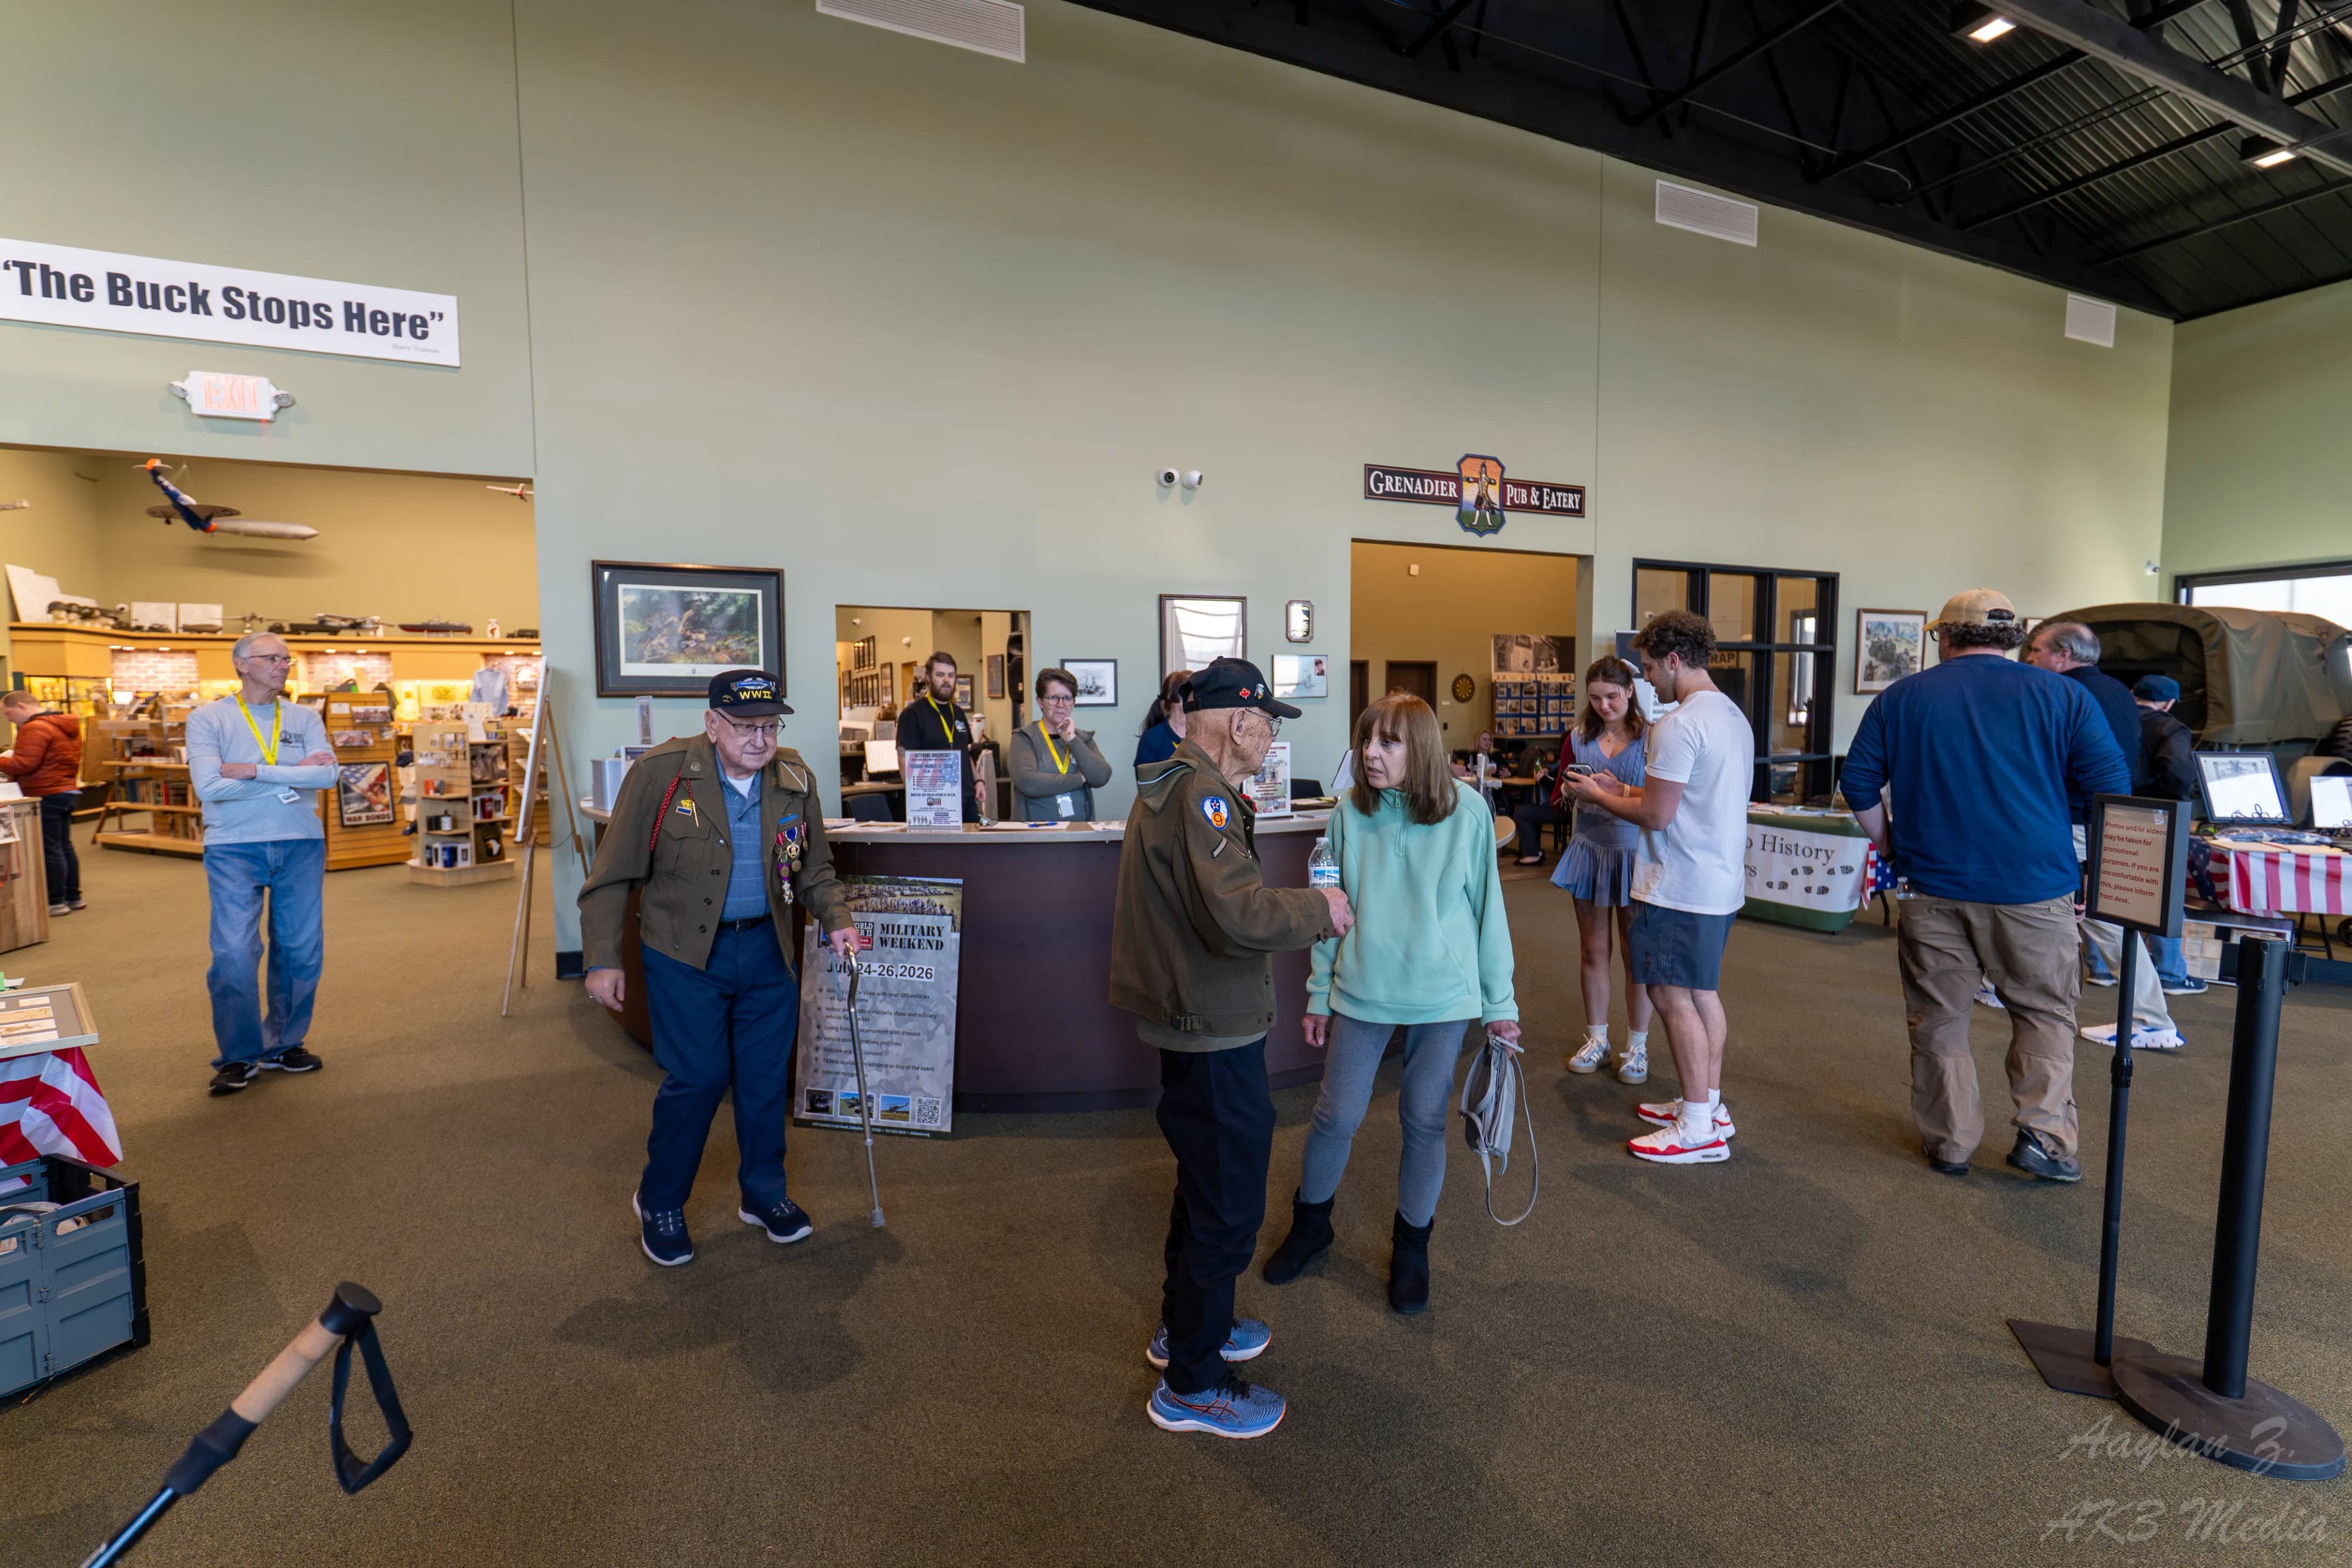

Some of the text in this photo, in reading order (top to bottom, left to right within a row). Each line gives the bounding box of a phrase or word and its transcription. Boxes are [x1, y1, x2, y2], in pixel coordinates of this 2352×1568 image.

[107, 272, 213, 317] Buck
[222, 285, 334, 330] Stops
[203, 375, 258, 412] EXIT
[1370, 470, 1581, 510] GRENADIER PUB & EATERY
[1213, 813, 1223, 827] 9
[2105, 821, 2125, 829] Photos
[1759, 834, 1835, 865] History
[2103, 845, 2138, 857] promotional
[2102, 858, 2131, 868] purposes.
[2101, 870, 2144, 883] uncomfortable
[2100, 880, 2155, 897] this, please inform
[2114, 895, 2130, 904] desk.
[880, 923, 945, 937] MILITARY
[879, 937, 944, 950] WEEKEND
